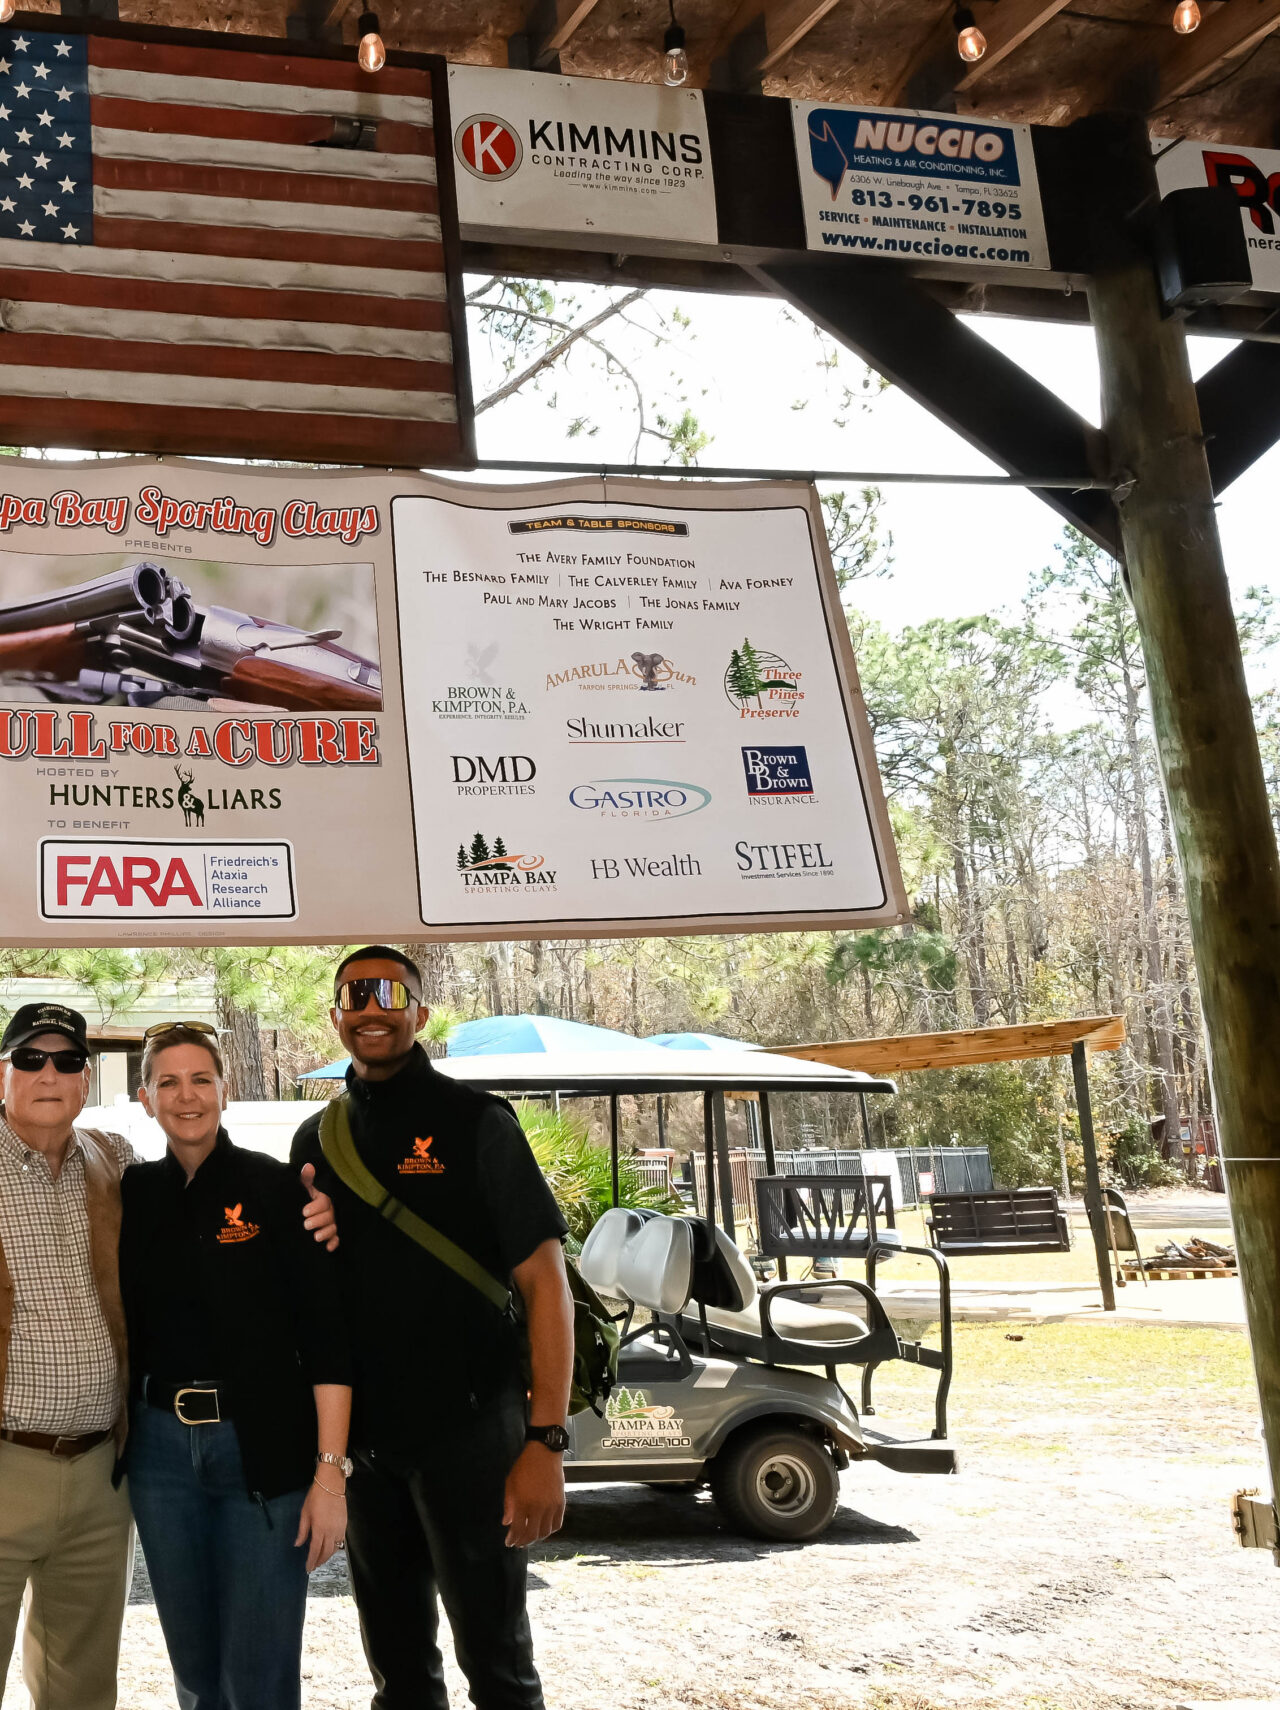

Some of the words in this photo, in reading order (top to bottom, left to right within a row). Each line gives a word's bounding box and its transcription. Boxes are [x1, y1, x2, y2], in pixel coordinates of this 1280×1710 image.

[529, 119, 703, 164] KIMMINS
[853, 118, 1004, 163] NUCCIO
[531, 154, 653, 174] CONTRACTING
[662, 165, 705, 179] CORP.
[853, 154, 892, 166] HEATING
[903, 158, 917, 168] AIR
[919, 161, 987, 177] CONDITIONING,
[554, 169, 592, 181] Leading
[595, 172, 611, 181] the
[635, 176, 660, 186] since
[582, 183, 658, 195] www.kimmins.com
[850, 174, 871, 184] 6306
[886, 178, 925, 191] Linebaugh
[992, 189, 1019, 199] 33625
[851, 189, 1022, 220] 813-961-7895
[819, 210, 861, 225] SERVICE
[872, 215, 947, 233] MAINTENANCE
[957, 223, 1027, 240] INSTALLATION
[821, 231, 1031, 263] www.nuccioac.com
[50, 489, 129, 534] Bay
[135, 485, 277, 545] Sporting
[281, 499, 379, 544] Clays
[525, 520, 563, 530] TEAM
[578, 519, 613, 528] TABLE
[617, 521, 676, 533] SPONSORS
[125, 540, 192, 553] PRESENTS
[516, 552, 542, 564] THE
[582, 553, 621, 566] FAMILY
[626, 554, 696, 569] FOUNDATION
[422, 571, 448, 583] THE
[453, 570, 506, 584] BESNARD
[510, 572, 550, 585] FAMILY
[568, 575, 589, 587] THE
[594, 576, 658, 587] CALVERLEY
[663, 576, 697, 589] FAMILY
[746, 577, 794, 590] FORNEY
[573, 597, 616, 609] JACOBS
[702, 600, 740, 611] FAMILY
[553, 618, 574, 630] THE
[579, 619, 631, 630] WRIGHT
[636, 618, 674, 630] FAMILY
[546, 658, 630, 691] AMARULA
[763, 669, 802, 680] Three
[448, 686, 502, 699] BROWN
[505, 687, 516, 699] &
[769, 689, 805, 700] Pines
[432, 700, 506, 715] KIMPTON,
[508, 701, 531, 714] P.A.
[740, 708, 800, 719] Preserve
[566, 716, 685, 738] Shumaker
[109, 722, 180, 756] FOR
[185, 727, 212, 756] A
[213, 718, 379, 766] CURE
[36, 767, 94, 777] HOSTED
[100, 769, 119, 778] BY
[450, 755, 537, 783] DMD
[776, 766, 789, 778] &
[50, 784, 174, 809] HUNTERS
[207, 788, 282, 810] LIARS
[457, 785, 536, 796] PROPERTIES
[569, 785, 687, 809] GASTRO
[749, 795, 815, 806] INSURANCE
[601, 810, 672, 818] FLORIDA
[47, 820, 66, 829] TO
[73, 821, 131, 830] BENEFIT
[735, 841, 833, 871] STIFEL
[591, 858, 620, 880] HB
[624, 853, 702, 878] Wealth
[56, 855, 204, 907] FARA
[210, 856, 279, 867] Friedreich's
[211, 869, 248, 881] Ataxia
[461, 872, 522, 886] TAMPA
[525, 870, 557, 885] BAY
[212, 883, 268, 894] Research
[464, 886, 520, 895] SPORTING
[524, 884, 559, 893] CLAYS
[212, 897, 262, 908] Alliance
[609, 1420, 654, 1431] TAMPA
[658, 1419, 683, 1430] BAY
[602, 1438, 664, 1448] CARRYALL
[667, 1437, 691, 1448] 100
